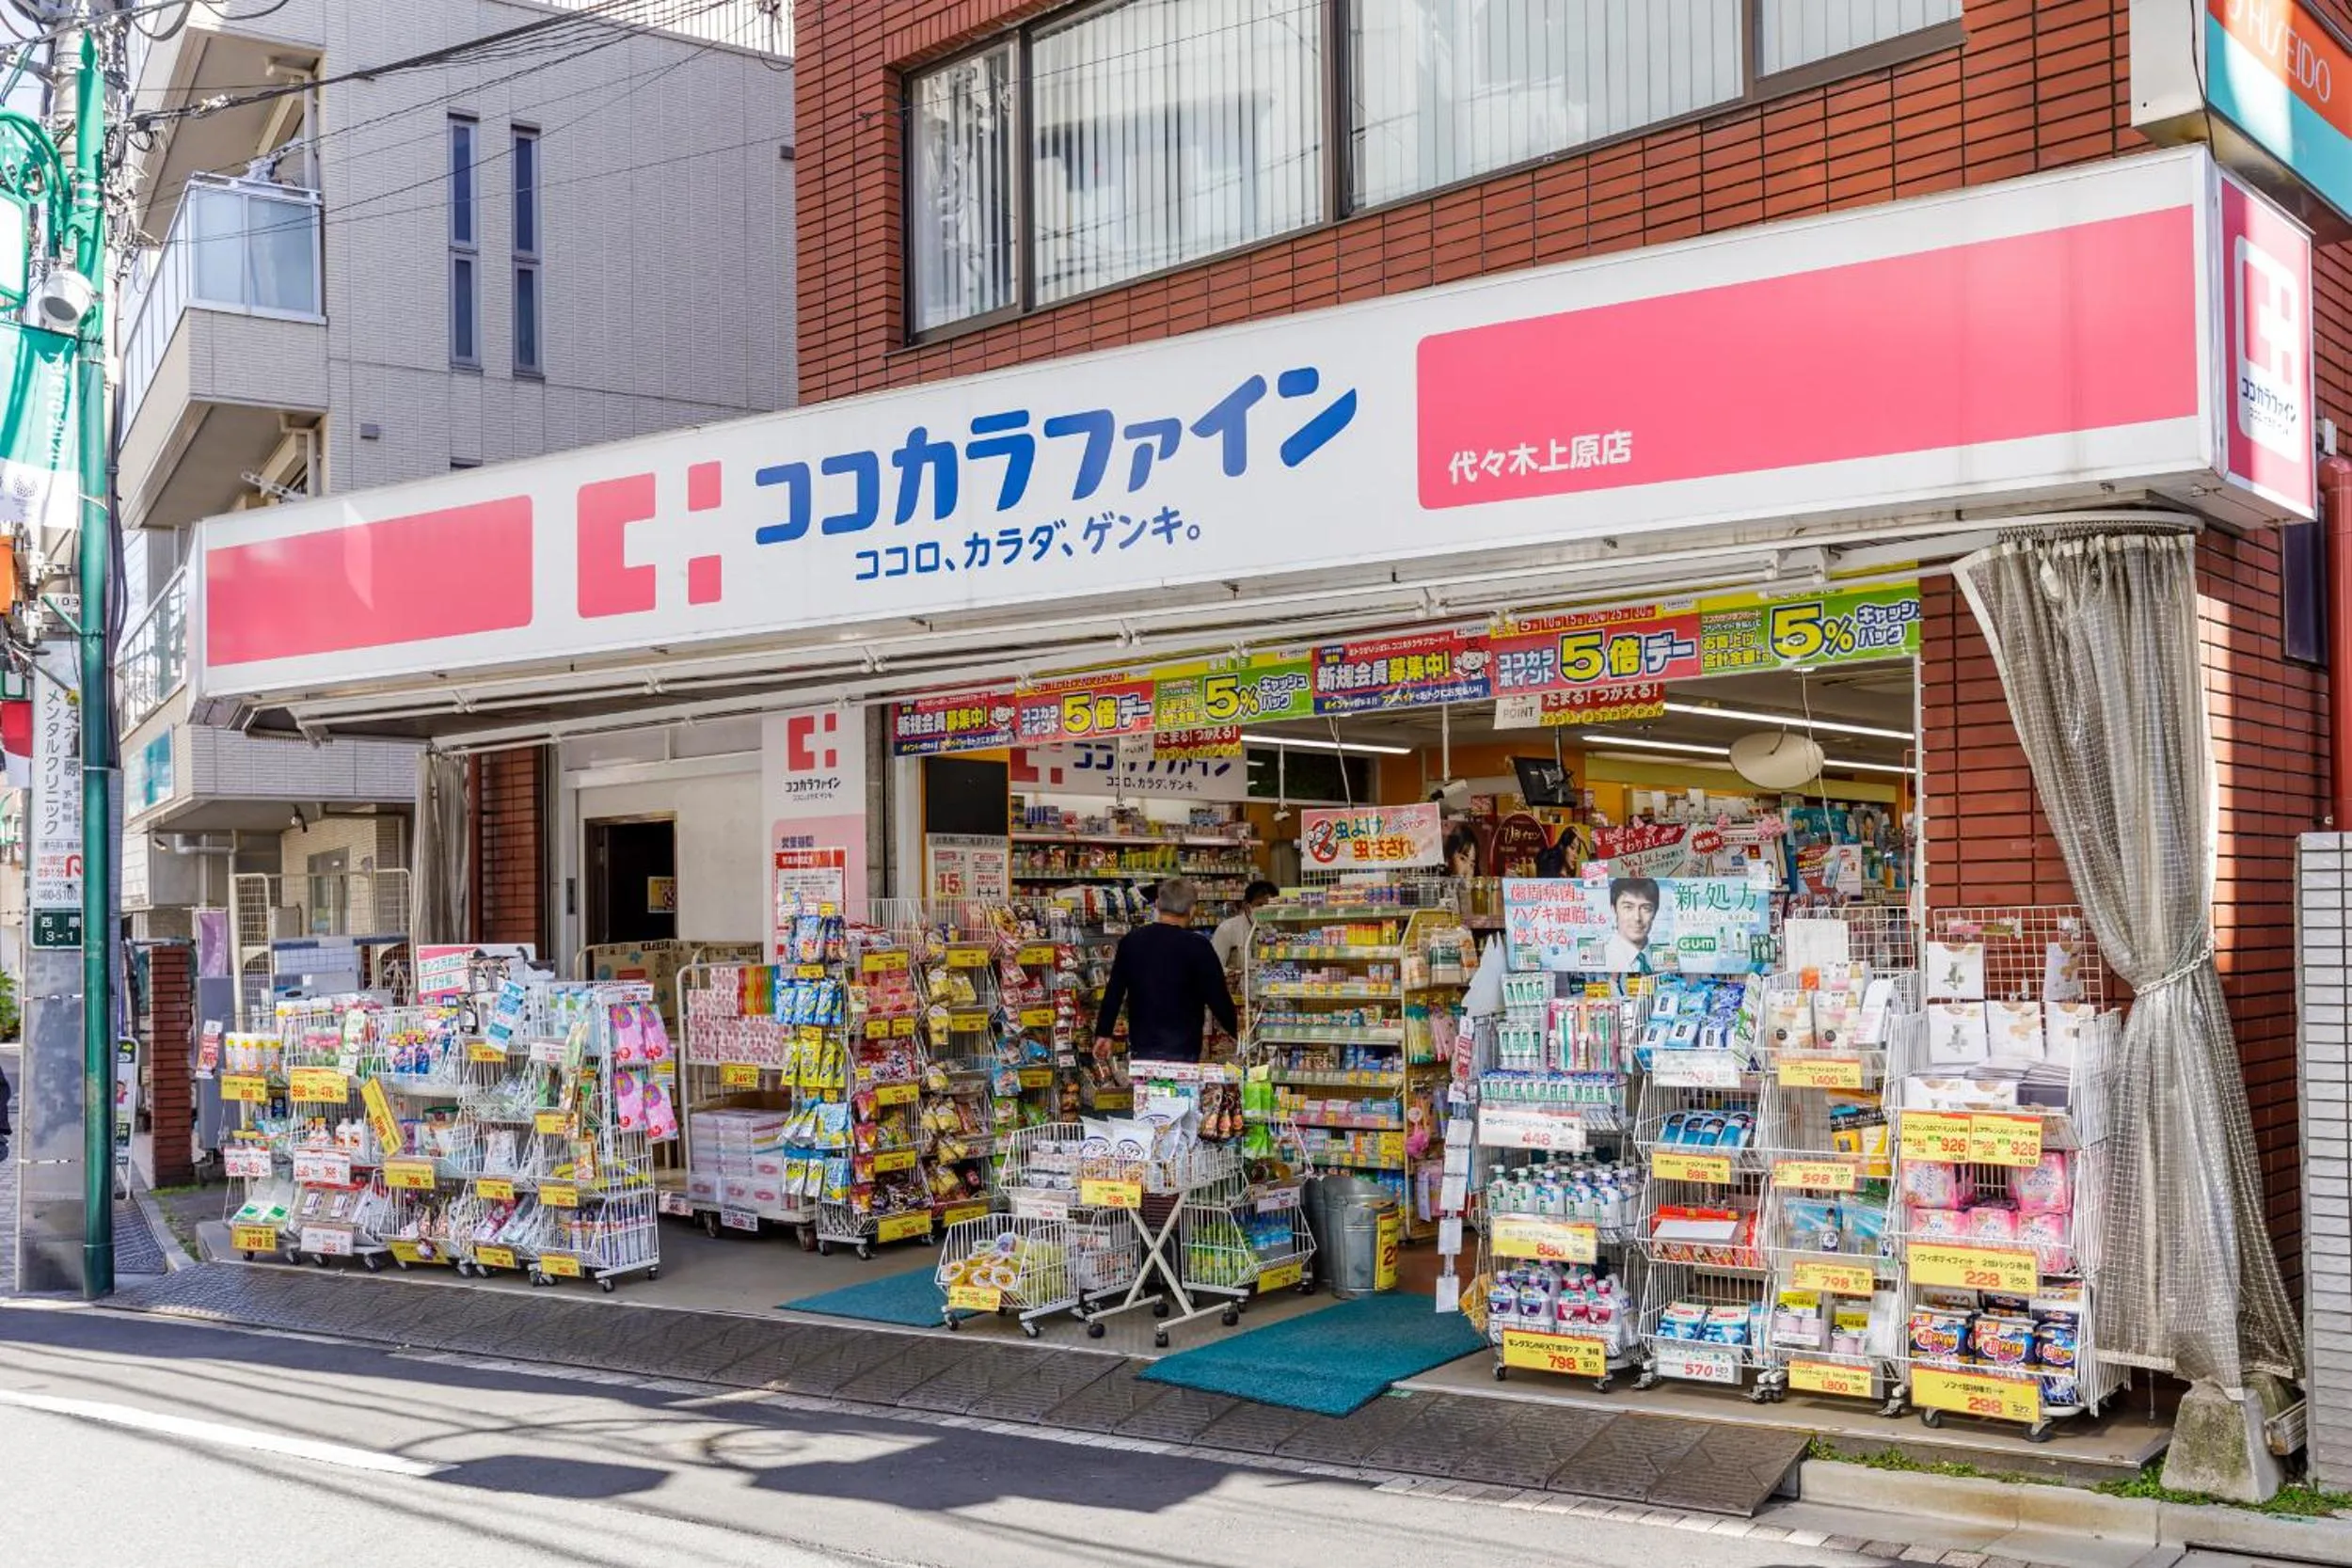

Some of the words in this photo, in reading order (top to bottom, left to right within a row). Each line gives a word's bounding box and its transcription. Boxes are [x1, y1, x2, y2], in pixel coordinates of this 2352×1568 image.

[755, 367, 1357, 545] ココカラファイン
[1449, 430, 1633, 485] 代々木上原店
[856, 505, 1201, 581] ココロ、カラダ、ゲンキ。
[1857, 601, 1920, 625] キャッシ
[1772, 603, 1855, 658] 5%
[1858, 624, 1905, 647] バック
[1499, 649, 1554, 670] ココカラ
[1560, 629, 1695, 682] 5倍デー
[1317, 650, 1451, 692] 新規会員募集中!
[1500, 669, 1555, 688] ポイント
[1260, 674, 1309, 692] キャッシュ
[1204, 673, 1260, 720] 5%
[897, 705, 989, 736] 新規会員募集中!
[1021, 705, 1059, 722] ココカラ
[1062, 692, 1152, 735] 5倍デー
[1021, 720, 1059, 736] ポイント
[45, 689, 60, 835] メンタルクリニック
[785, 777, 841, 793] ココカラファイン
[1336, 816, 1383, 840] 虫よけ
[1941, 1137, 1966, 1153] 926
[2010, 1141, 2038, 1156] 926
[1964, 1270, 2000, 1288] 228
[1548, 1354, 1578, 1370] 798
[1685, 1363, 1713, 1377] 570
[1968, 1397, 2003, 1414] 298
